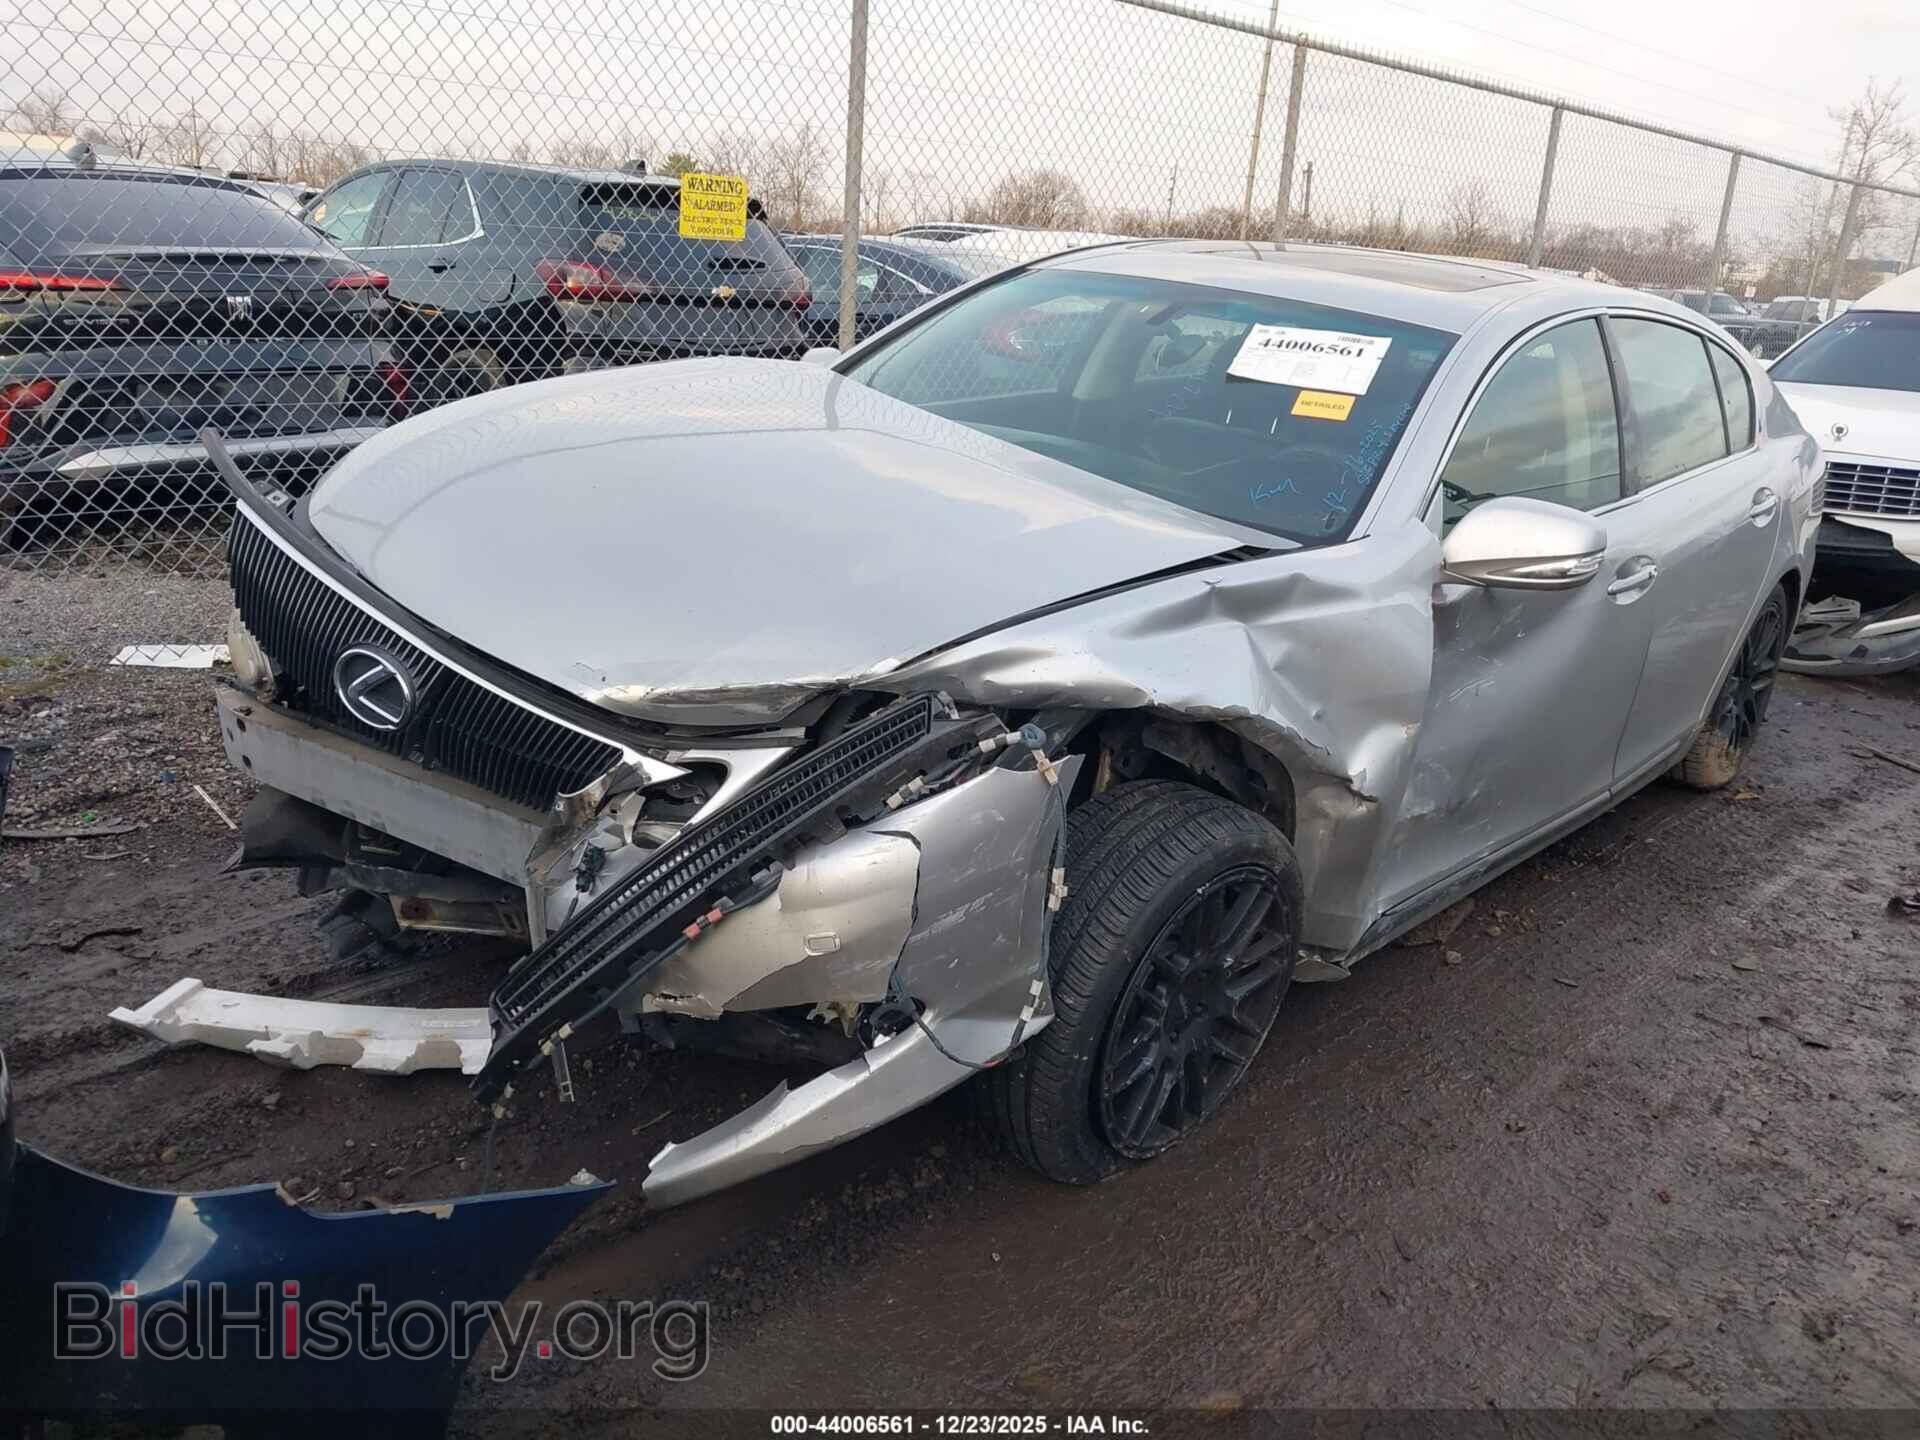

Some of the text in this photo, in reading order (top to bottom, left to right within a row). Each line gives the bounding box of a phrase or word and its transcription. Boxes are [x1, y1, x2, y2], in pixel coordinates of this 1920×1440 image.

[687, 177, 743, 195] WARNING
[692, 199, 736, 212] ALARMED
[1257, 337, 1365, 359] 44006561
[1300, 400, 1346, 411] DETAILED
